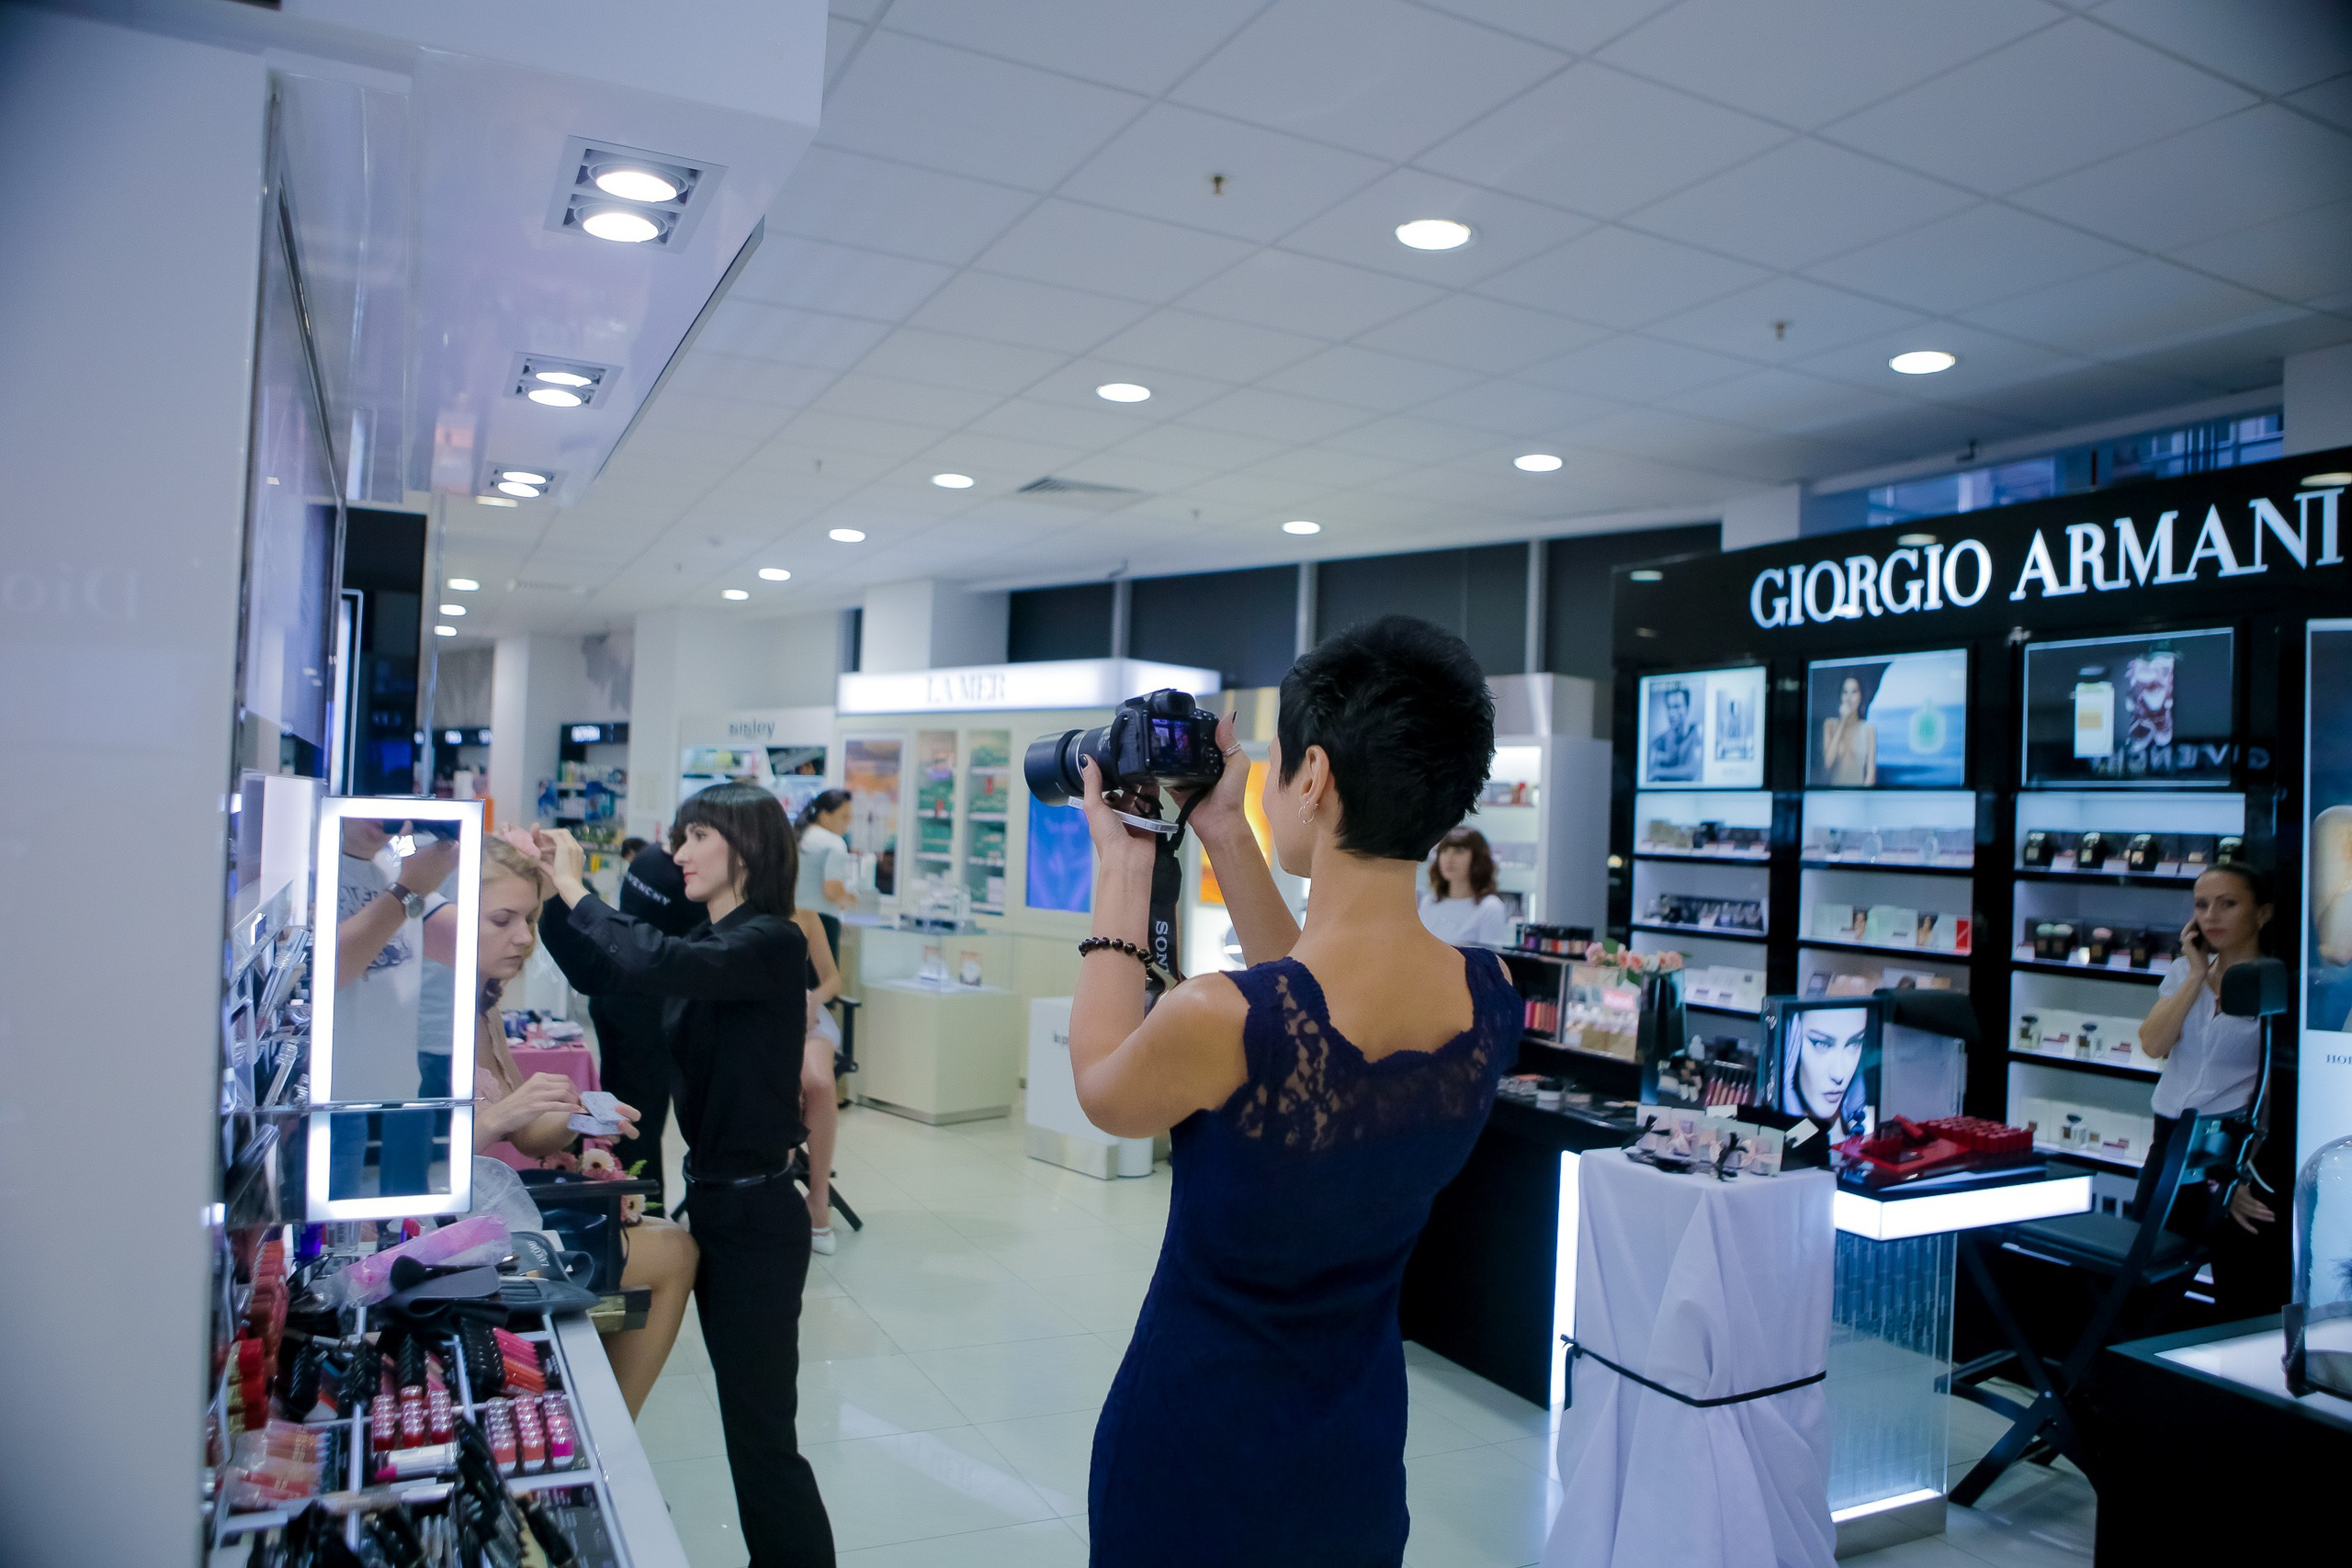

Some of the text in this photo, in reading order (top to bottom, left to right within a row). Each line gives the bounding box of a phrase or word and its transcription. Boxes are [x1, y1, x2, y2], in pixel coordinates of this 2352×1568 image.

[1750, 487, 2345, 629] GIORGIO ARMANI
[959, 671, 1005, 701] MER
